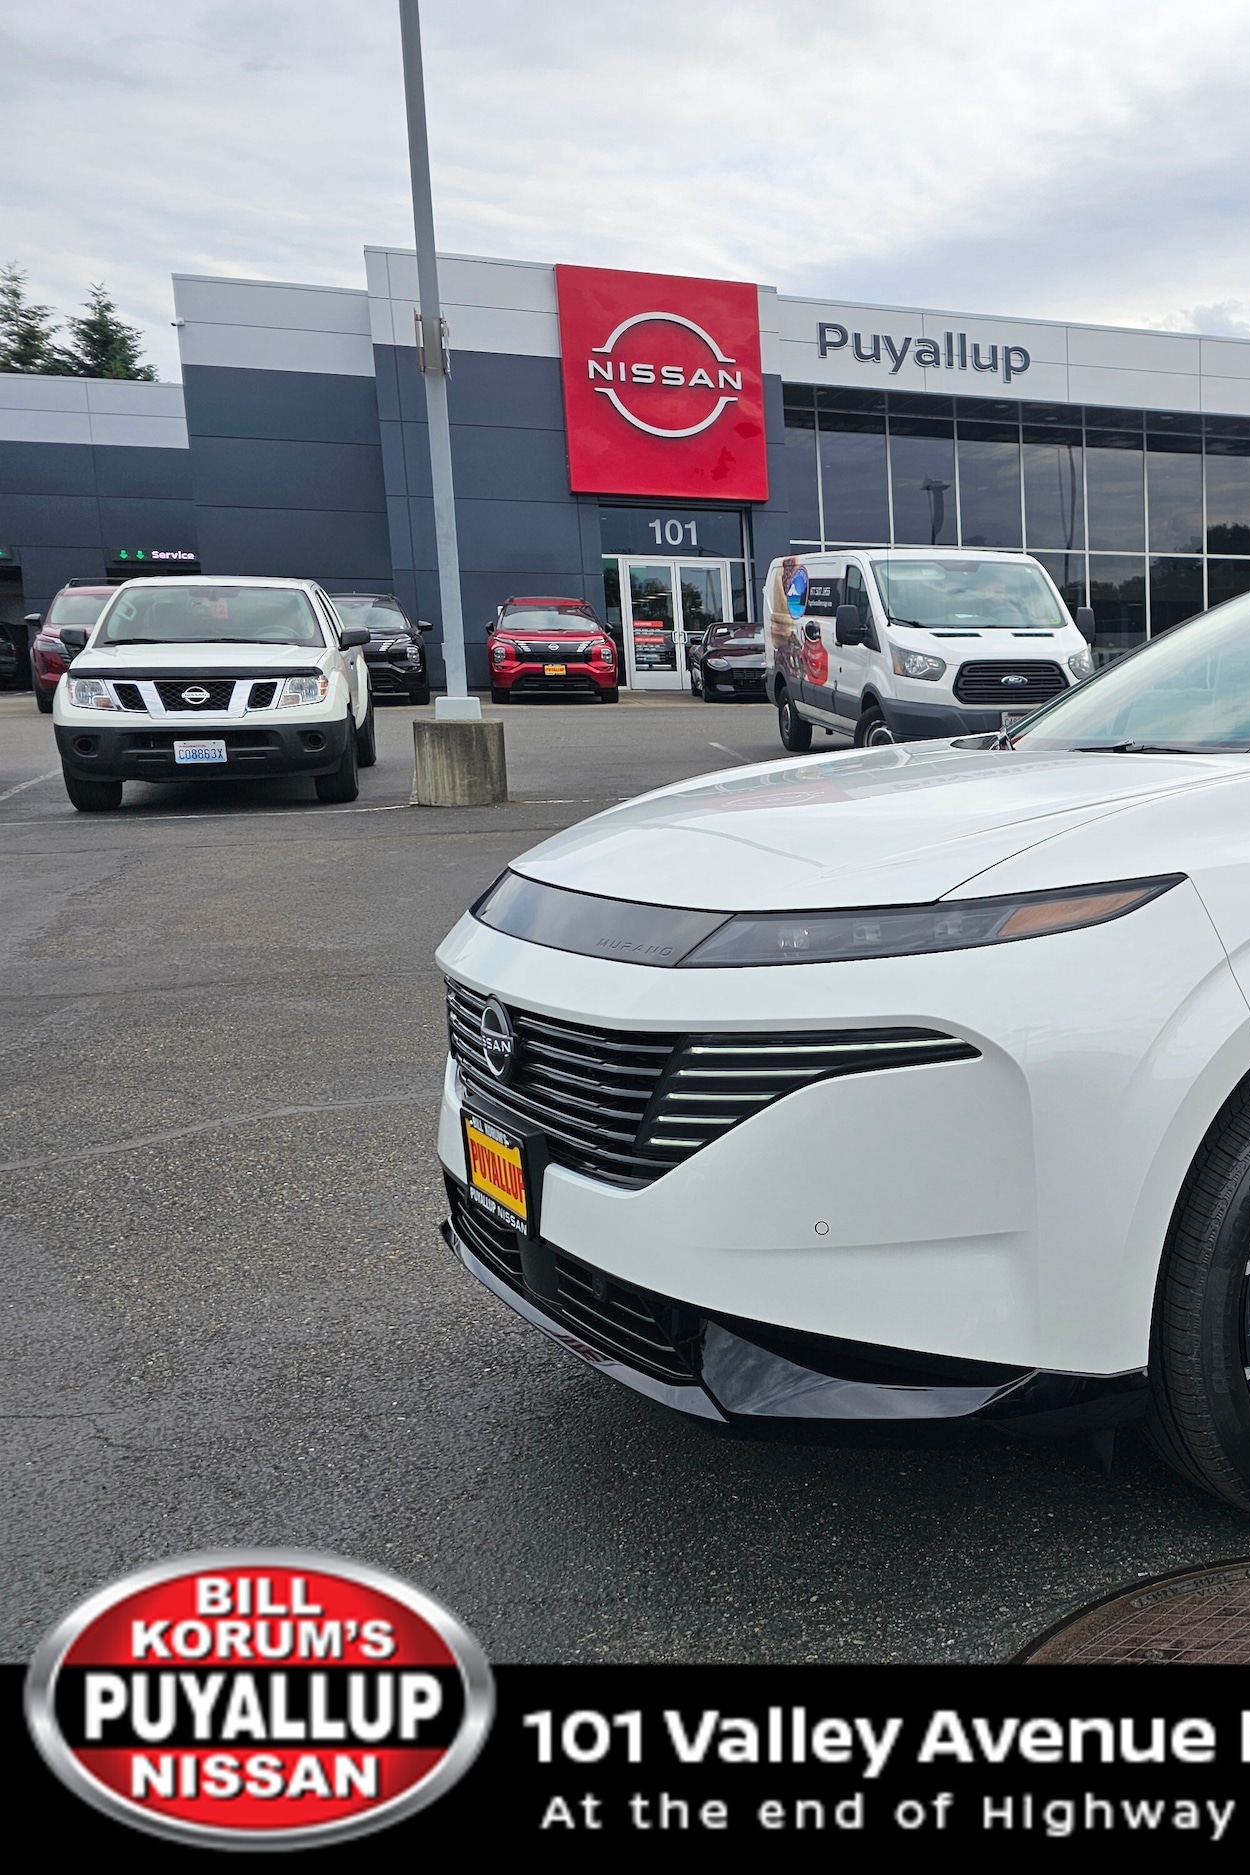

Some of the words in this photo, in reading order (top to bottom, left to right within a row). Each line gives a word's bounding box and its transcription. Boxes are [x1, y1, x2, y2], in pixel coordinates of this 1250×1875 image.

[816, 322, 1031, 383] Puyallup
[588, 359, 742, 391] NISSAN
[648, 519, 698, 546] 101
[151, 551, 195, 560] Service
[597, 938, 673, 956] MURANO
[470, 1186, 496, 1214] PUYALLUP
[497, 1205, 527, 1236] NISSAN
